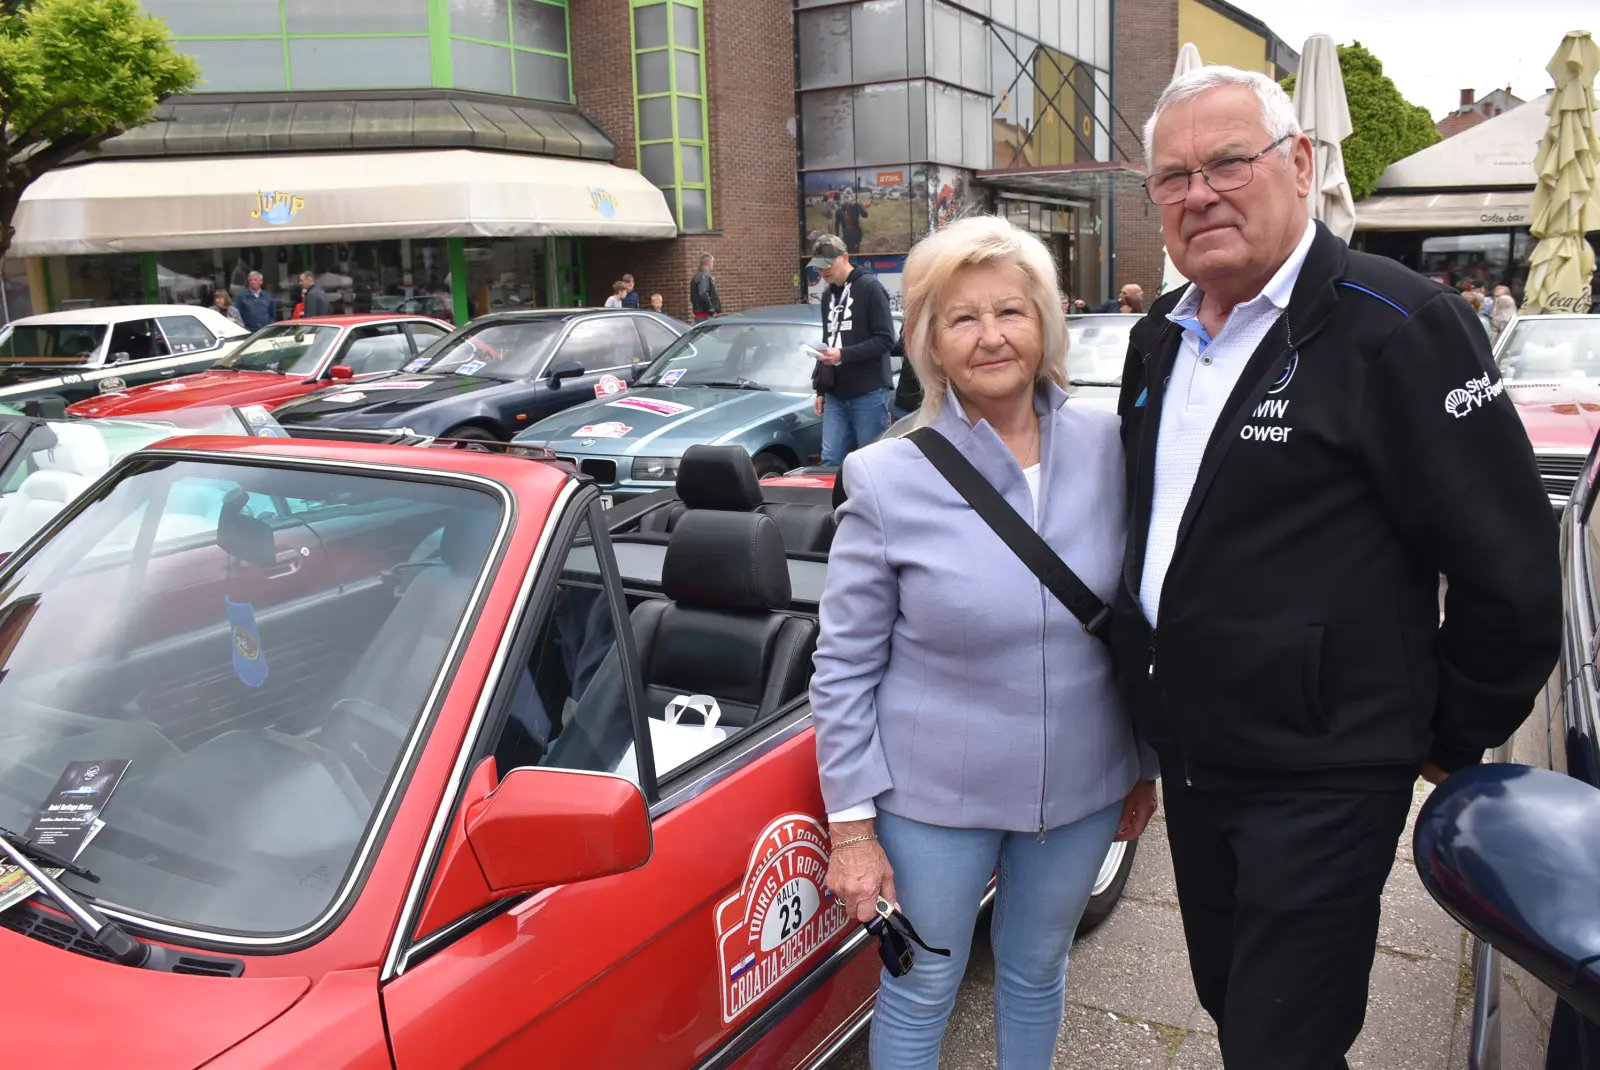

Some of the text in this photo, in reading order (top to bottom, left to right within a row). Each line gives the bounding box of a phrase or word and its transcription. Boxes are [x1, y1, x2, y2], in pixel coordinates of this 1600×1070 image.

[251, 189, 305, 219] jump
[1506, 212, 1524, 222] bar
[63, 374, 81, 384] 400
[1251, 399, 1290, 419] MW
[1239, 424, 1293, 443] ower
[776, 879, 800, 906] RALLY
[779, 895, 802, 940] 23
[731, 951, 778, 1015] CROATIA
[779, 930, 804, 974] 2025
